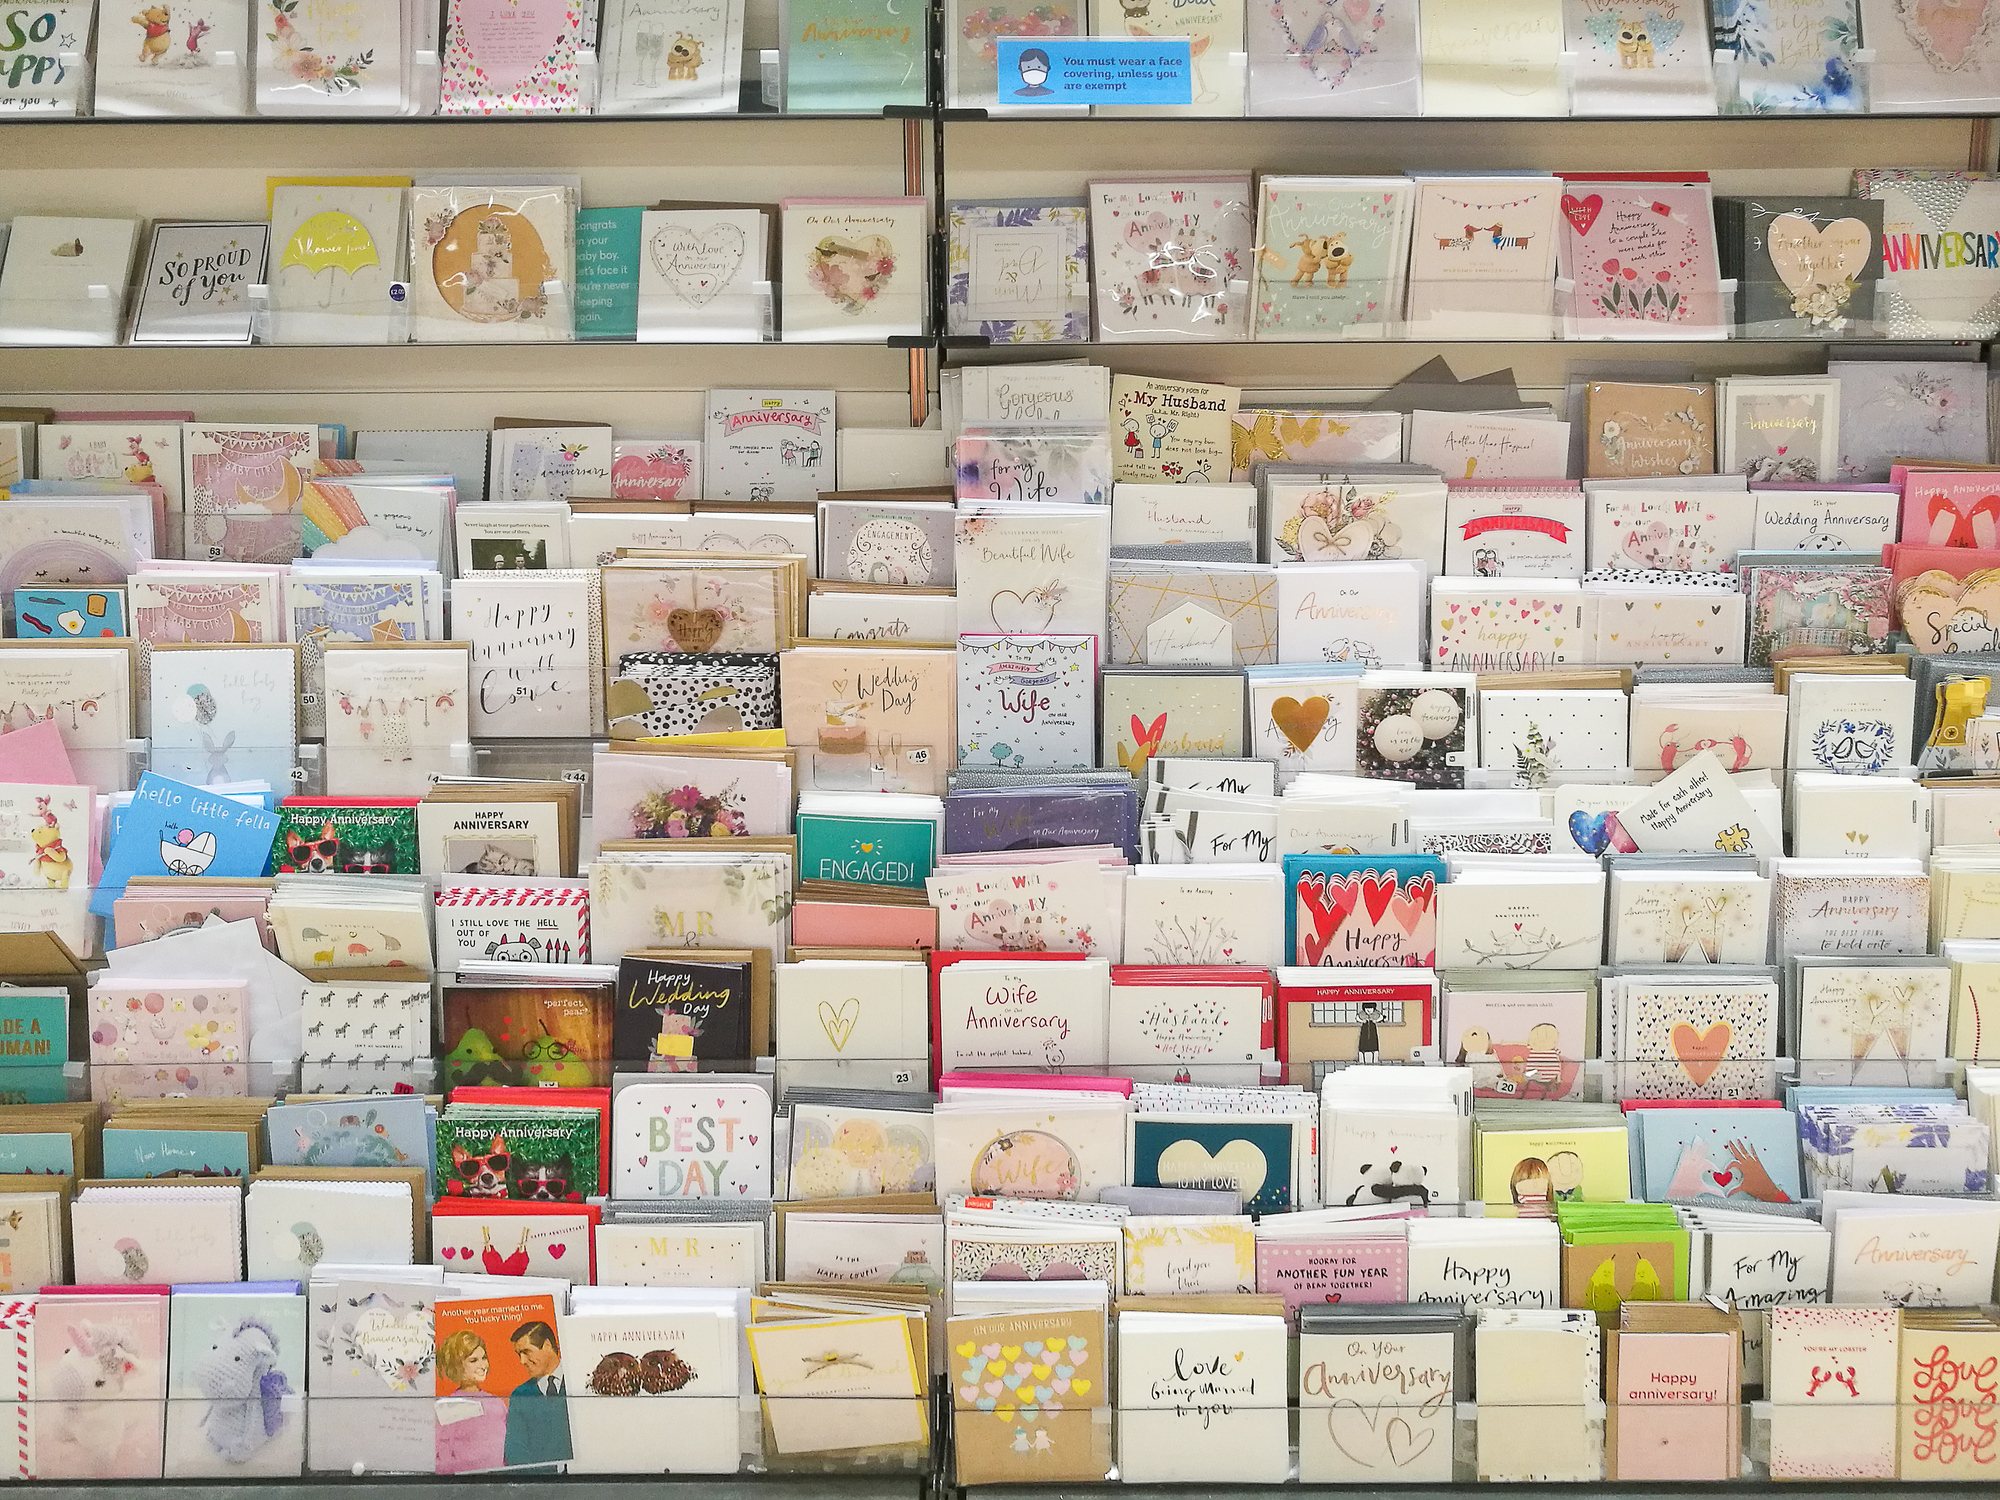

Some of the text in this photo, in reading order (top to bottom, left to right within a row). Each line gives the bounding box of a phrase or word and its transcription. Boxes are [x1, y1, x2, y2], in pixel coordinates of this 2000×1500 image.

[0, 10, 56, 51] SO
[1064, 57, 1083, 67] You
[1086, 57, 1112, 66] must
[1115, 58, 1140, 66] wear
[1153, 57, 1183, 66] face
[1064, 69, 1177, 80] covering, unless you
[1064, 81, 1126, 92] are exempt
[20, 96, 40, 107] you
[806, 215, 894, 227] On Our Anniversary
[1615, 211, 1642, 223] Happy
[586, 235, 608, 247] your
[672, 241, 697, 254] With
[598, 250, 619, 262] boy.
[159, 248, 251, 287] SO PROUD
[597, 264, 628, 275] face it
[667, 259, 730, 273] Anniversary
[173, 272, 245, 305] of you
[602, 280, 630, 290] never
[1146, 382, 1153, 390] An
[1154, 383, 1184, 394] anniversary
[1185, 386, 1199, 394] poem
[999, 385, 1074, 418] Gorgeous
[1134, 391, 1226, 412] My Husband
[732, 411, 812, 425] Anniversary
[1618, 436, 1693, 453] Anniversary
[1631, 454, 1677, 468] Wishes
[540, 467, 608, 478] anniversary
[991, 460, 1035, 480] for my
[612, 474, 686, 489] Anniversary
[1915, 485, 1949, 497] Happy
[1765, 509, 1889, 534] Wedding Anniversary
[867, 529, 914, 540] ENGAGEMENT
[209, 547, 220, 556] 63
[982, 545, 1075, 561] Beautiful Wife
[1927, 612, 1992, 644] Special
[1478, 626, 1530, 649] happy
[1452, 651, 1556, 671] ANNIVERSARY!
[516, 687, 527, 695] 51
[857, 668, 919, 699] Wedding
[882, 690, 915, 714] Day
[1000, 689, 1050, 723] Wife
[916, 751, 927, 759] 46
[291, 771, 302, 779] 42
[138, 780, 271, 830] hello little fella
[1640, 772, 1709, 824] Made for each other!
[1651, 788, 1712, 830] Happy Anniversary
[291, 814, 397, 825] Happy Anniversary
[453, 820, 529, 830] ANNIVERSARY
[1212, 830, 1276, 861] For My
[820, 859, 914, 881] ENGAGED!
[1809, 901, 1899, 922] Anniversary
[460, 919, 558, 927] STILL LOVE THE HELL
[458, 939, 476, 948] YOU
[1345, 928, 1406, 950] Happy
[1837, 939, 1862, 950] hold
[648, 970, 691, 987] Happy
[629, 979, 730, 1008] Wedding
[986, 984, 1037, 1006] Wife
[684, 1003, 709, 1018] Day
[30, 1019, 40, 1035] A
[966, 1007, 1069, 1039] Anniversary
[896, 1072, 909, 1082] 23
[1502, 1083, 1513, 1092] 20
[1728, 1089, 1738, 1097] 21
[456, 1127, 572, 1139] Happy Anniversary
[650, 1117, 741, 1152] BEST
[659, 1160, 728, 1196] DAY
[1211, 1178, 1240, 1188] LOVE
[651, 1237, 699, 1258] M R
[1855, 1236, 1977, 1275] Anniversary
[1277, 1267, 1388, 1278] ANOTHER FUN YEAR
[1444, 1257, 1510, 1287] Happy
[1734, 1251, 1802, 1281] For My
[442, 1308, 471, 1316] Another
[490, 1306, 520, 1314] married
[481, 1315, 499, 1323] lucky
[501, 1313, 522, 1322] thing!
[591, 1330, 685, 1341] HAPPY ANNIVERSARY
[1348, 1342, 1367, 1356] On
[1174, 1347, 1231, 1377] love
[1914, 1346, 1998, 1389] Love
[1651, 1372, 1697, 1387] Happy
[1151, 1383, 1196, 1401] being
[1304, 1362, 1454, 1416] Anniversary
[1629, 1388, 1718, 1401] anniversary!
[1914, 1385, 1998, 1427] Love
[1197, 1405, 1234, 1428] you
[1914, 1419, 1998, 1463] Love
